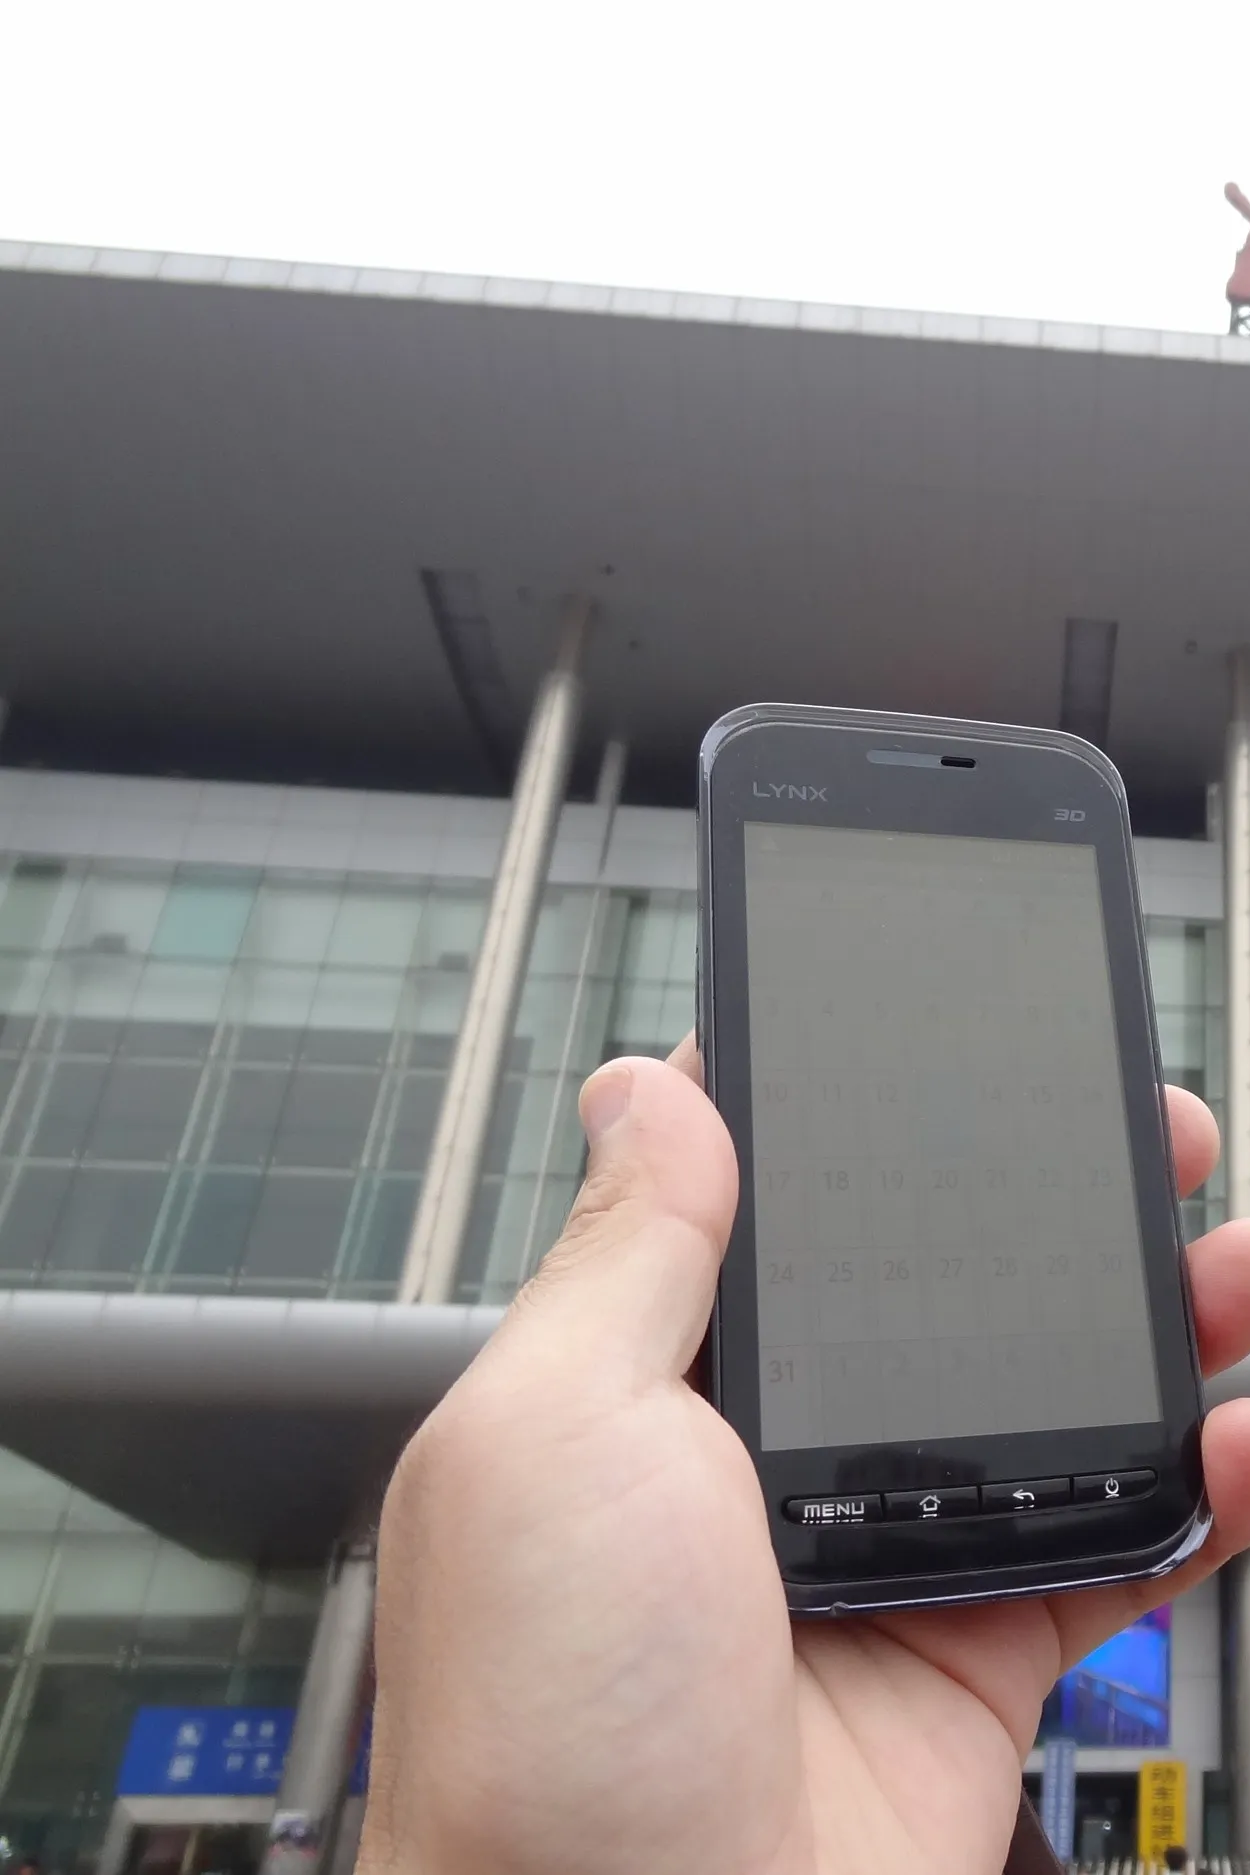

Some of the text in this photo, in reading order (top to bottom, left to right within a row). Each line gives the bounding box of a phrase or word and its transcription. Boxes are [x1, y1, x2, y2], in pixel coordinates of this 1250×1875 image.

[752, 781, 828, 802] LYNX
[1053, 808, 1087, 823] 3D
[766, 1171, 790, 1192] 17
[823, 1170, 850, 1191] 18
[931, 1169, 958, 1190] 20
[767, 1262, 794, 1284] 24
[827, 1261, 854, 1283] 25
[883, 1259, 910, 1281] 26
[938, 1257, 964, 1279] 27
[992, 1256, 1018, 1277] 28
[1046, 1254, 1070, 1275] 29
[768, 1360, 795, 1383] 31
[803, 1500, 865, 1519] MENU
